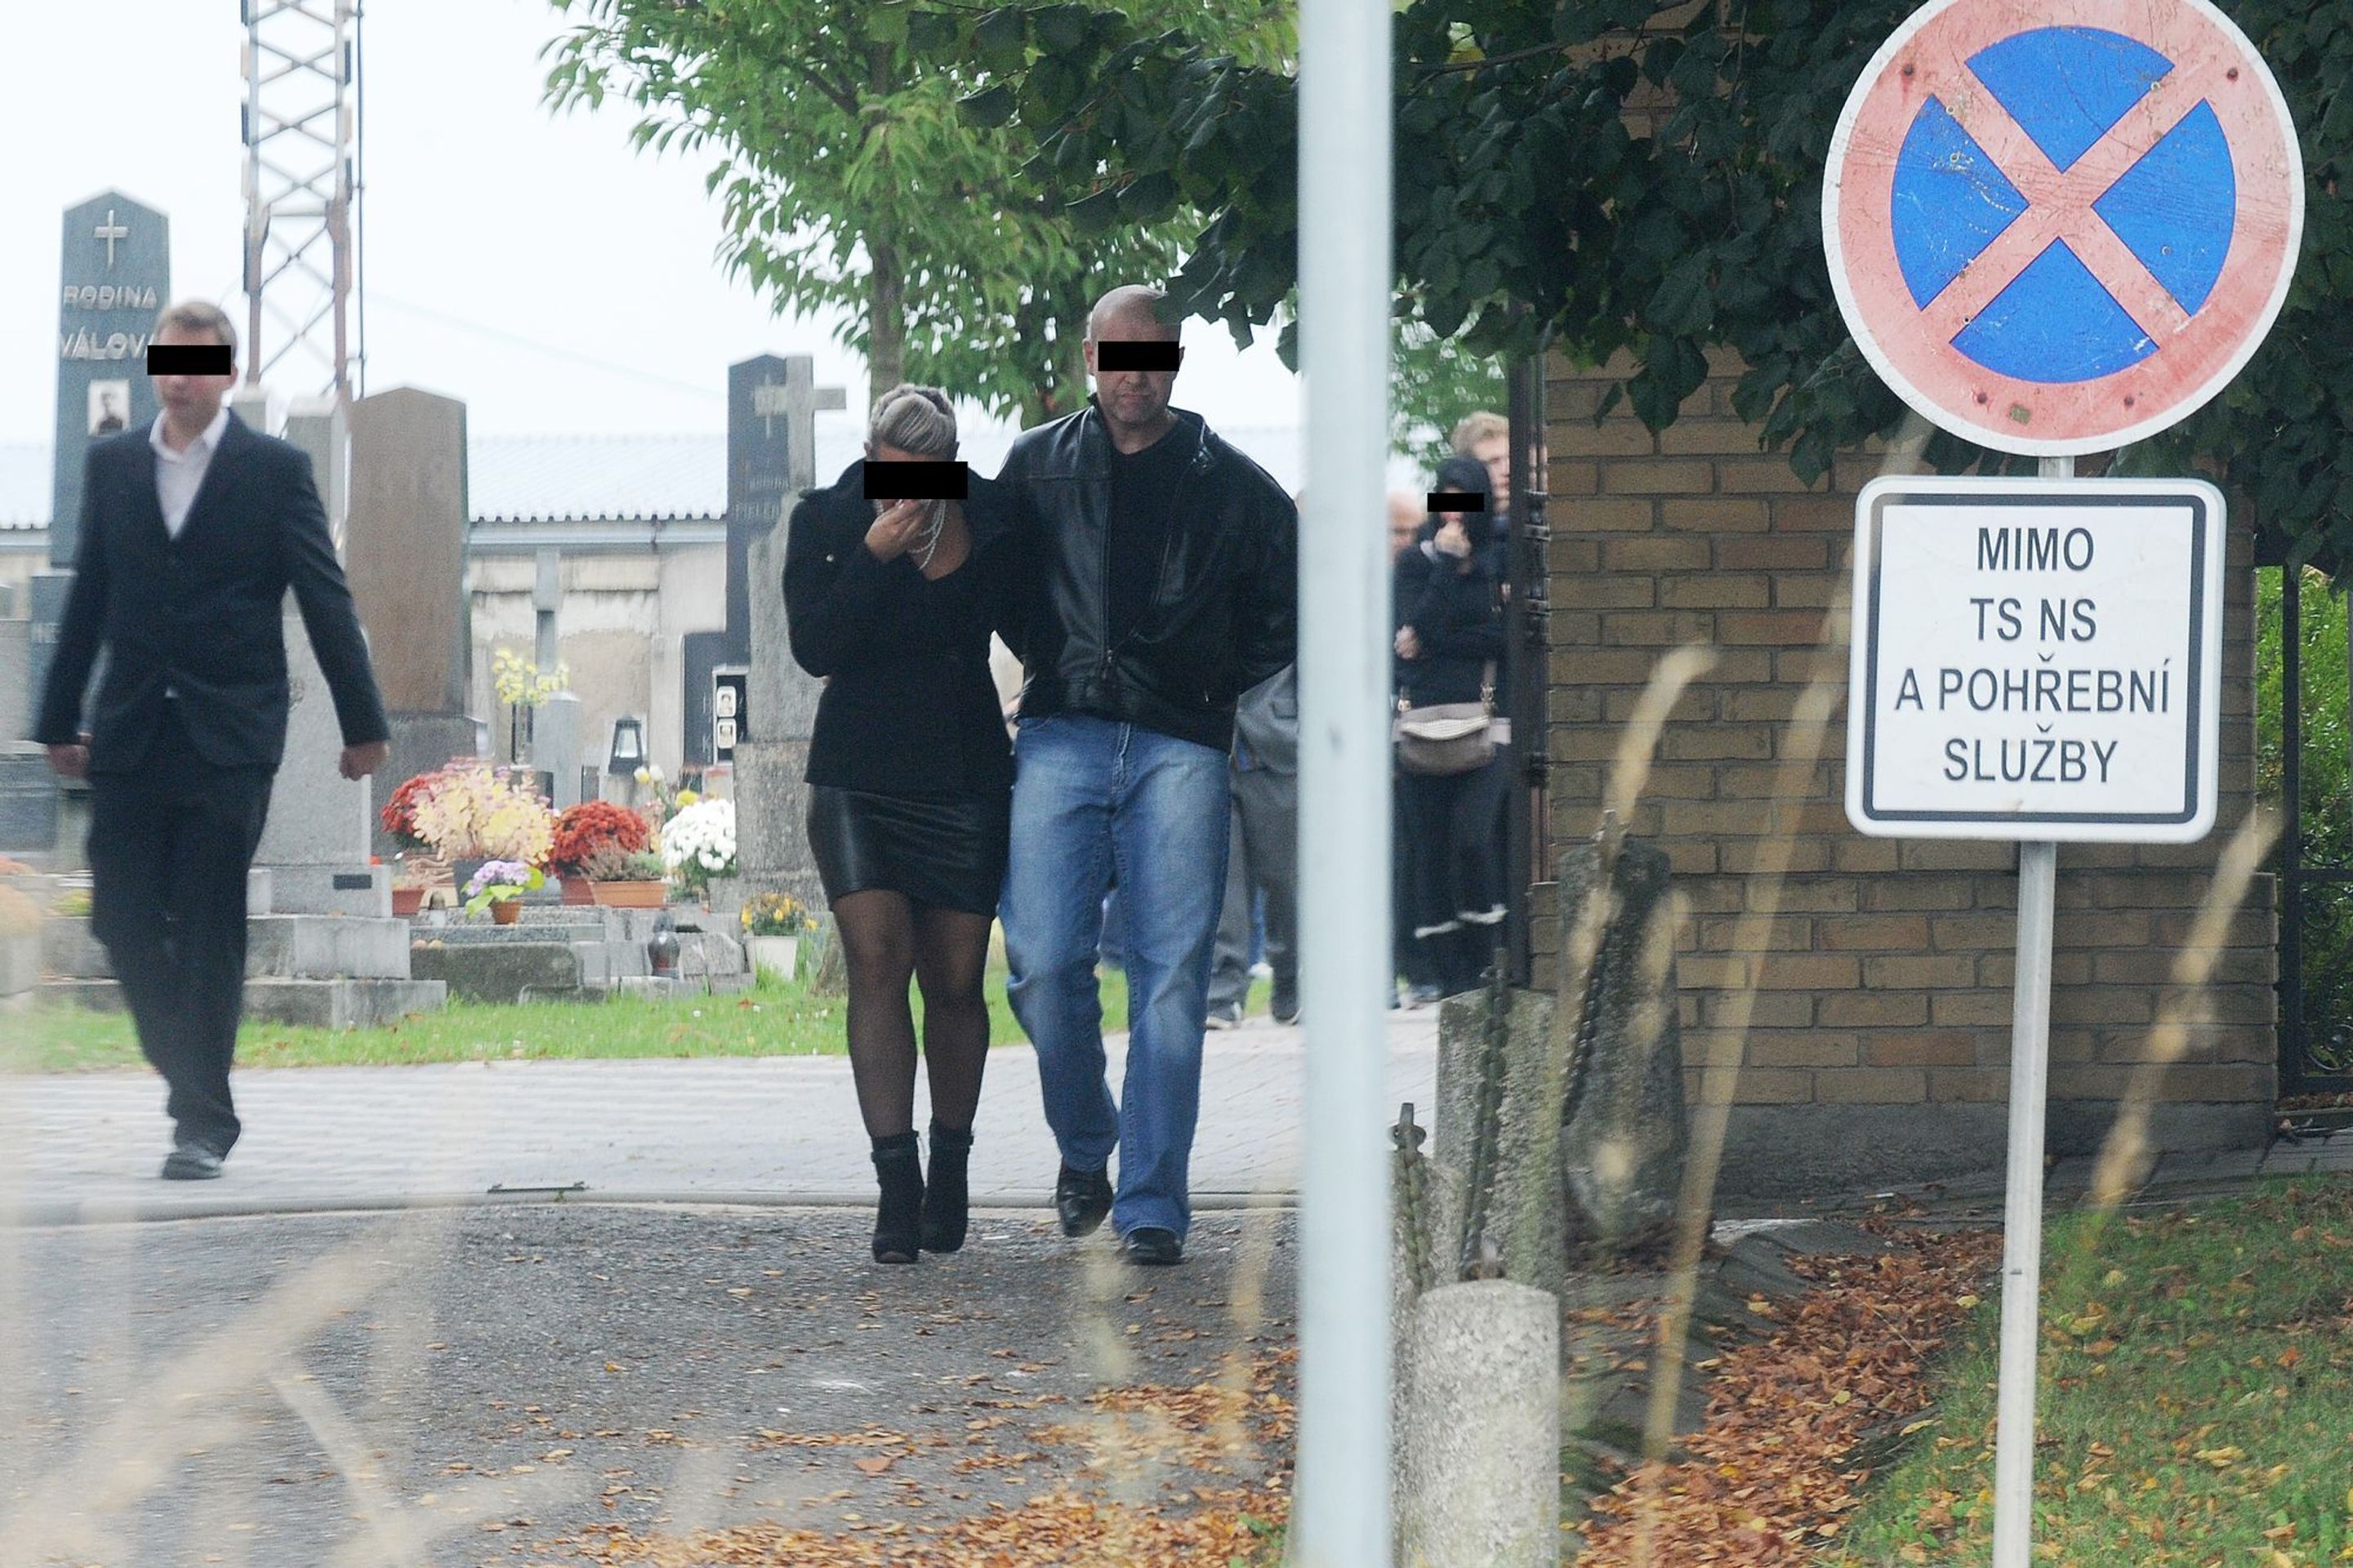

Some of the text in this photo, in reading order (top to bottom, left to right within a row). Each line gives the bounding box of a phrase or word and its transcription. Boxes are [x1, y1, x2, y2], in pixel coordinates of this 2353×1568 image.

[1976, 527, 2095, 572] MIMO
[1969, 598, 2097, 642] TS NS
[1894, 653, 2171, 714] A POHŘEBNÍ
[1943, 723, 2119, 783] SLUŽBY
